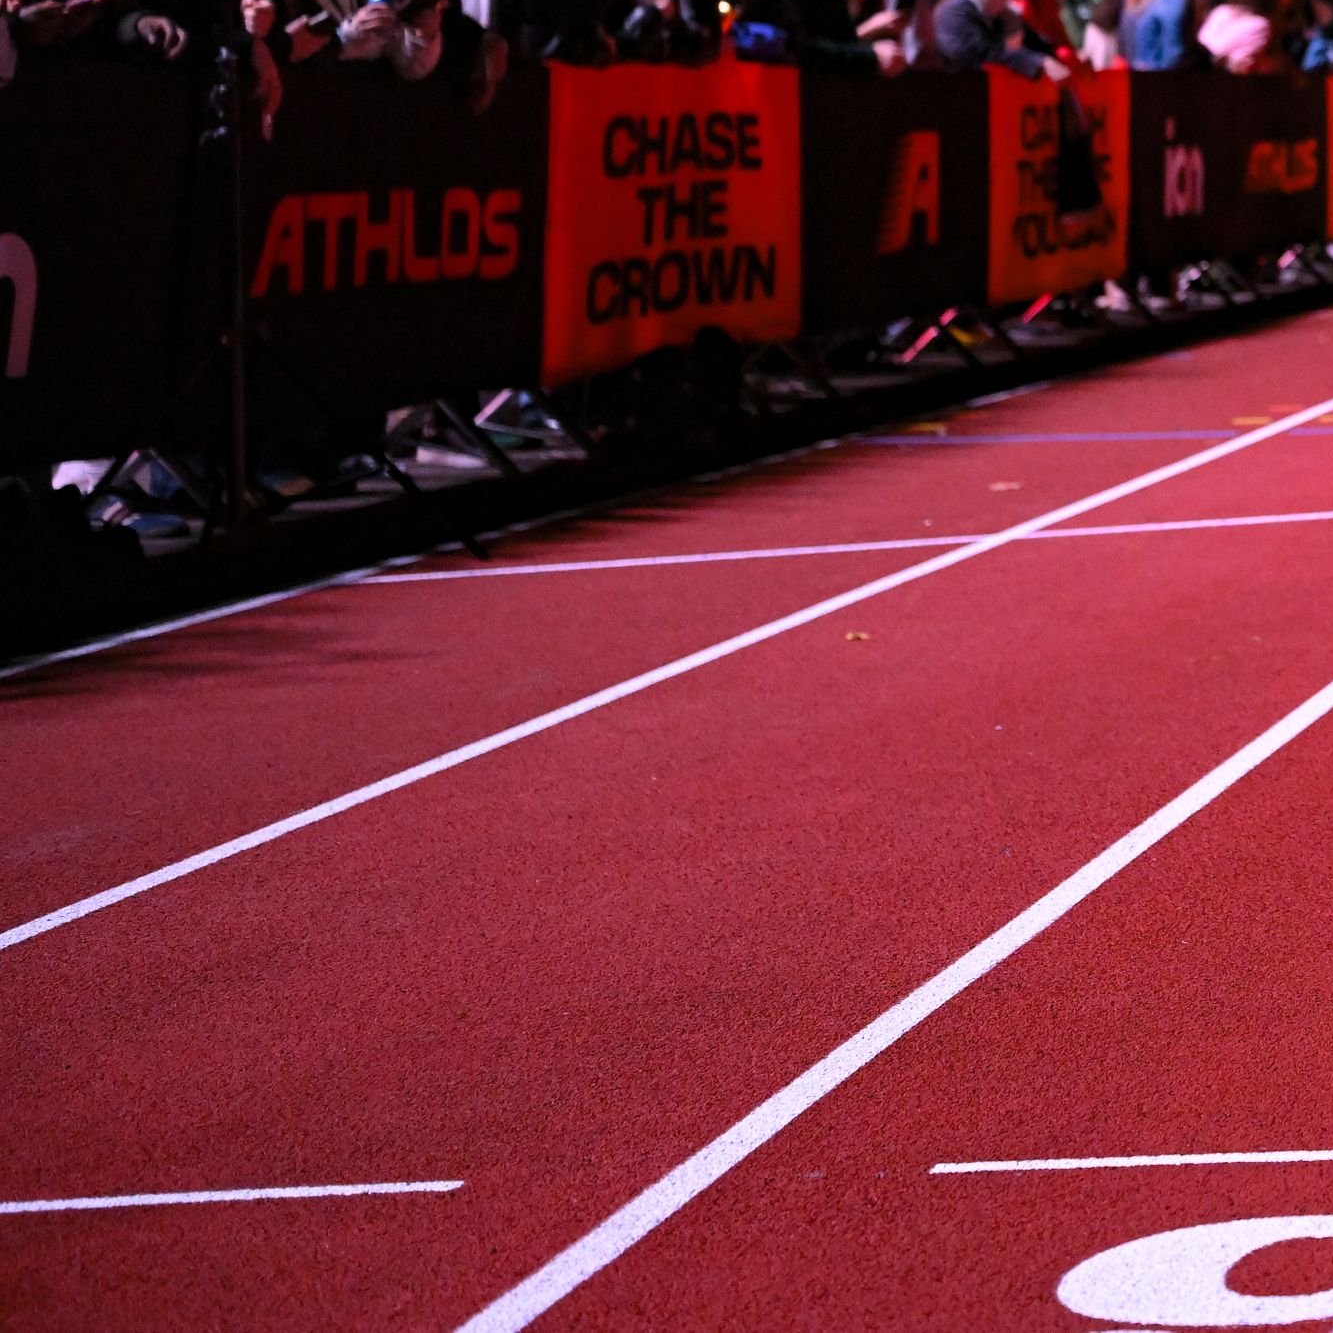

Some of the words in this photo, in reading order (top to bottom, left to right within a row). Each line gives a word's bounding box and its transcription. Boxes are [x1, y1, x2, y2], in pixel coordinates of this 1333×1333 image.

[602, 113, 762, 179] CHASE
[248, 186, 521, 299] ATHLOS
[637, 181, 728, 246] THE
[585, 246, 777, 326] CROWN
